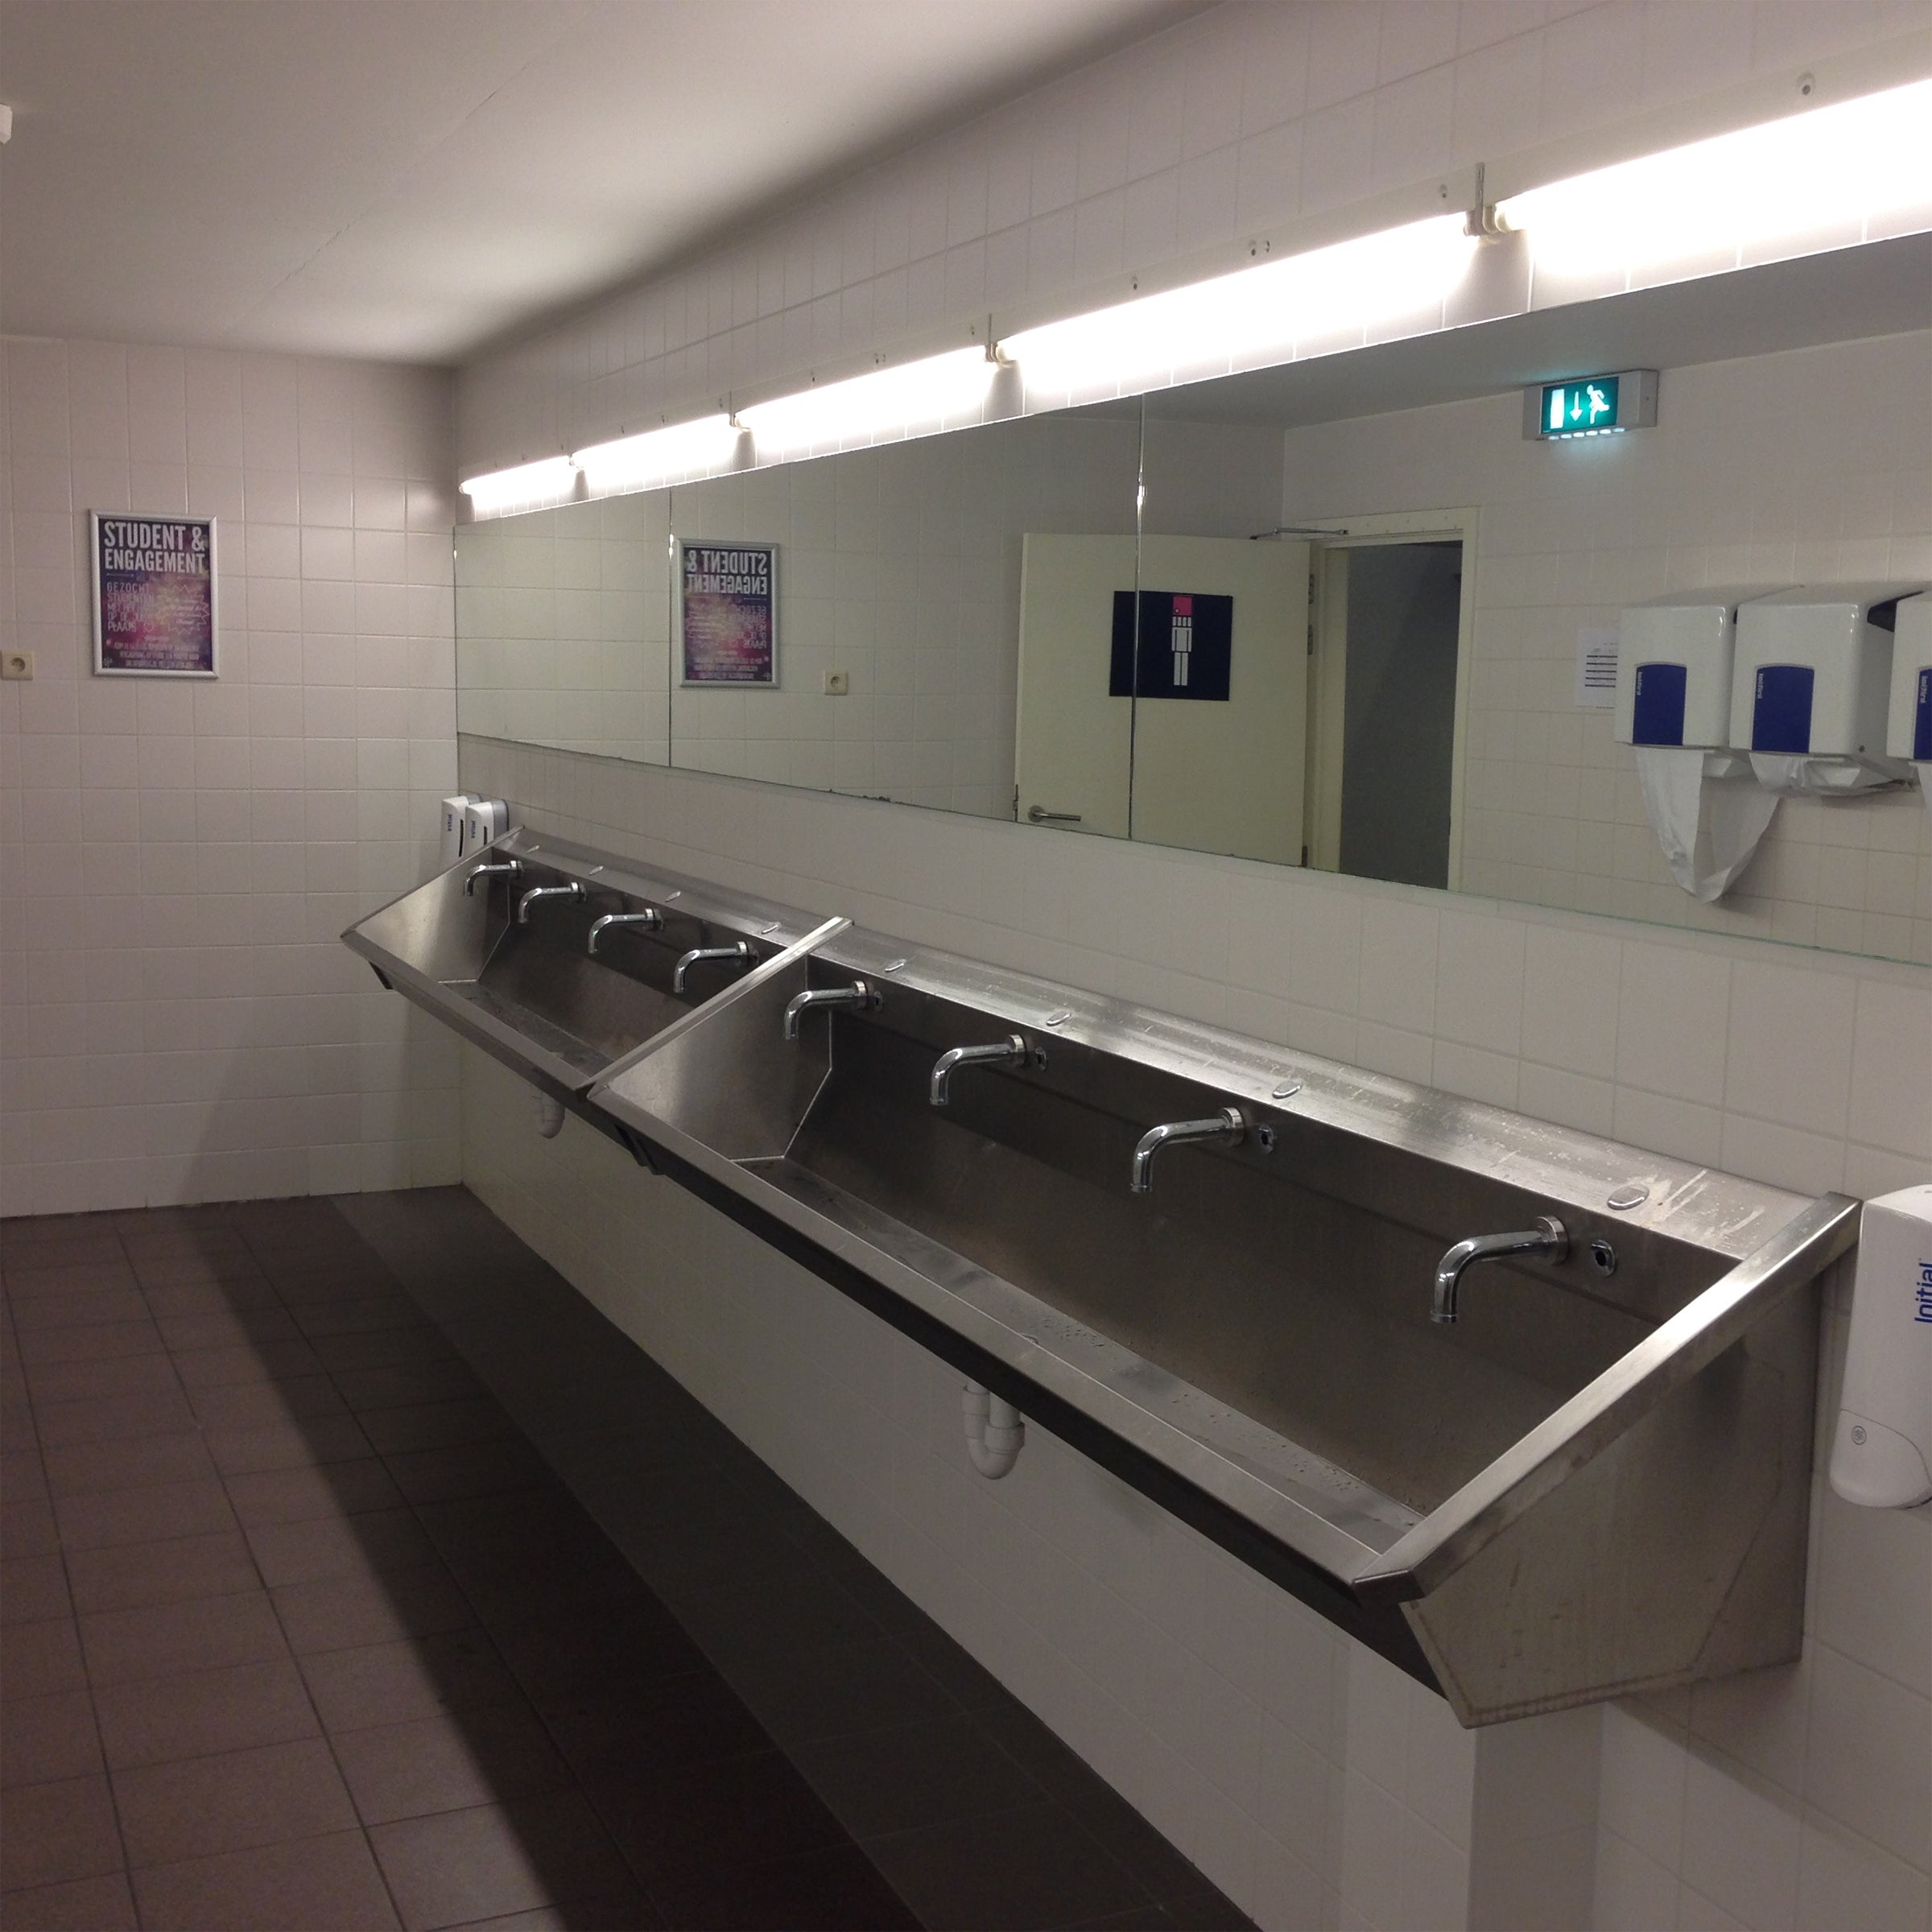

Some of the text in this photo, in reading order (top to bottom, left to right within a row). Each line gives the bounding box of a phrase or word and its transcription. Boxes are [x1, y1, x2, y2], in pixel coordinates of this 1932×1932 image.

[105, 522, 205, 551] STUDENT &
[105, 549, 205, 573] ENGAGEMENT
[1914, 1262, 1932, 1323] Initial
